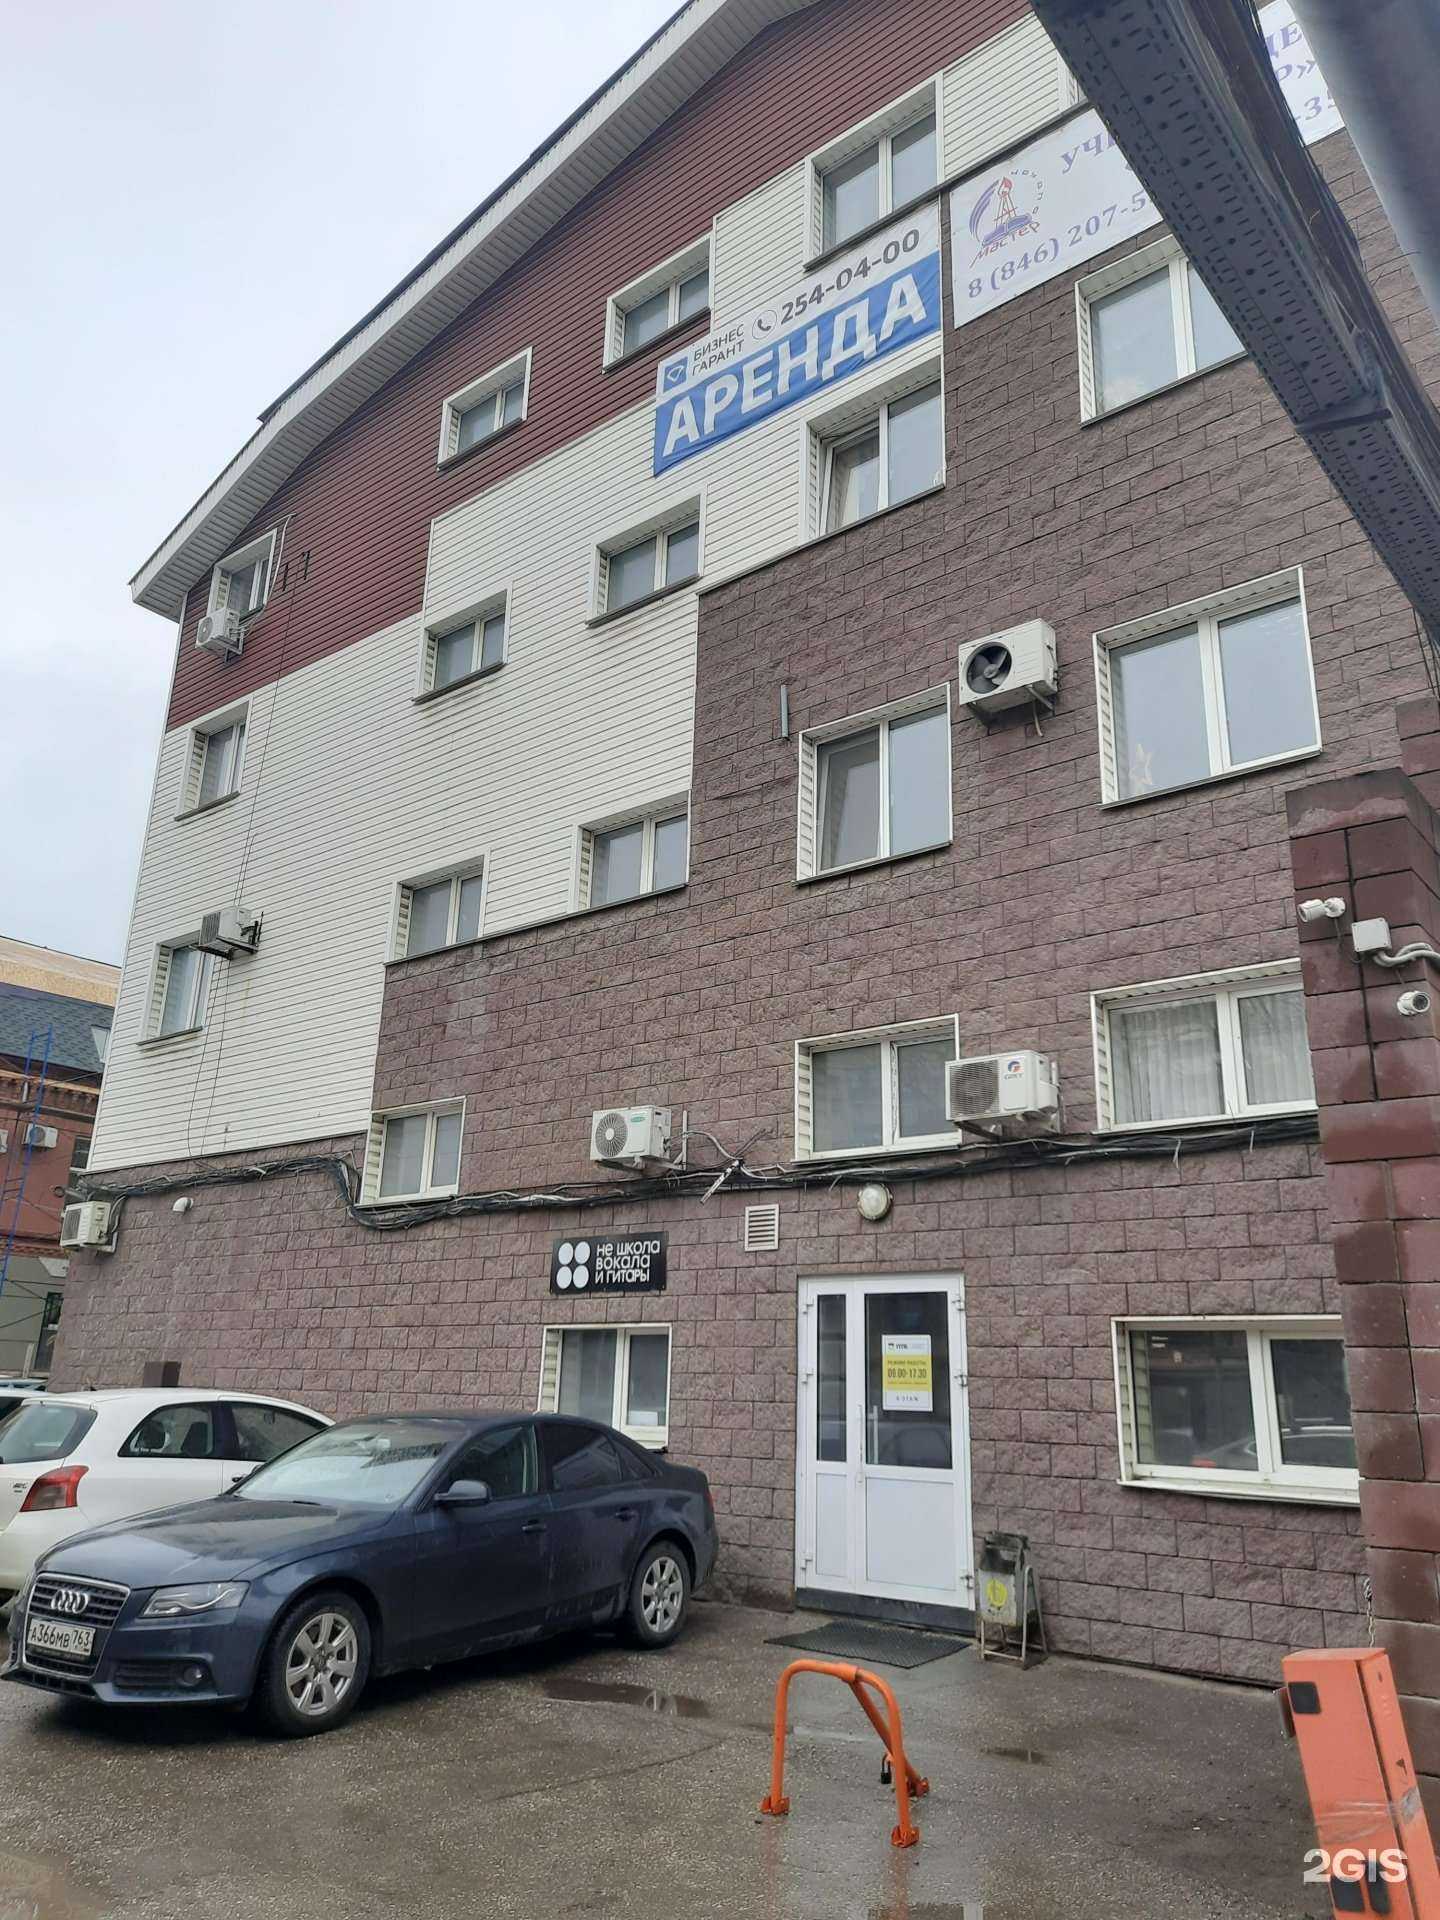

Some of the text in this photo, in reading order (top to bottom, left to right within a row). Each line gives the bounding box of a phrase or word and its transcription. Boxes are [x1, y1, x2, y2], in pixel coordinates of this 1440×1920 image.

[780, 228, 920, 325] 254-04-00
[968, 278, 982, 298] 8
[990, 237, 1060, 290] (846)
[663, 273, 927, 457] АРЕНДА
[692, 339, 745, 377] ГАРАНТ
[693, 323, 745, 361] БИЗНЕС
[31, 1623, 71, 1649] А366МВ
[72, 1629, 91, 1647] 763
